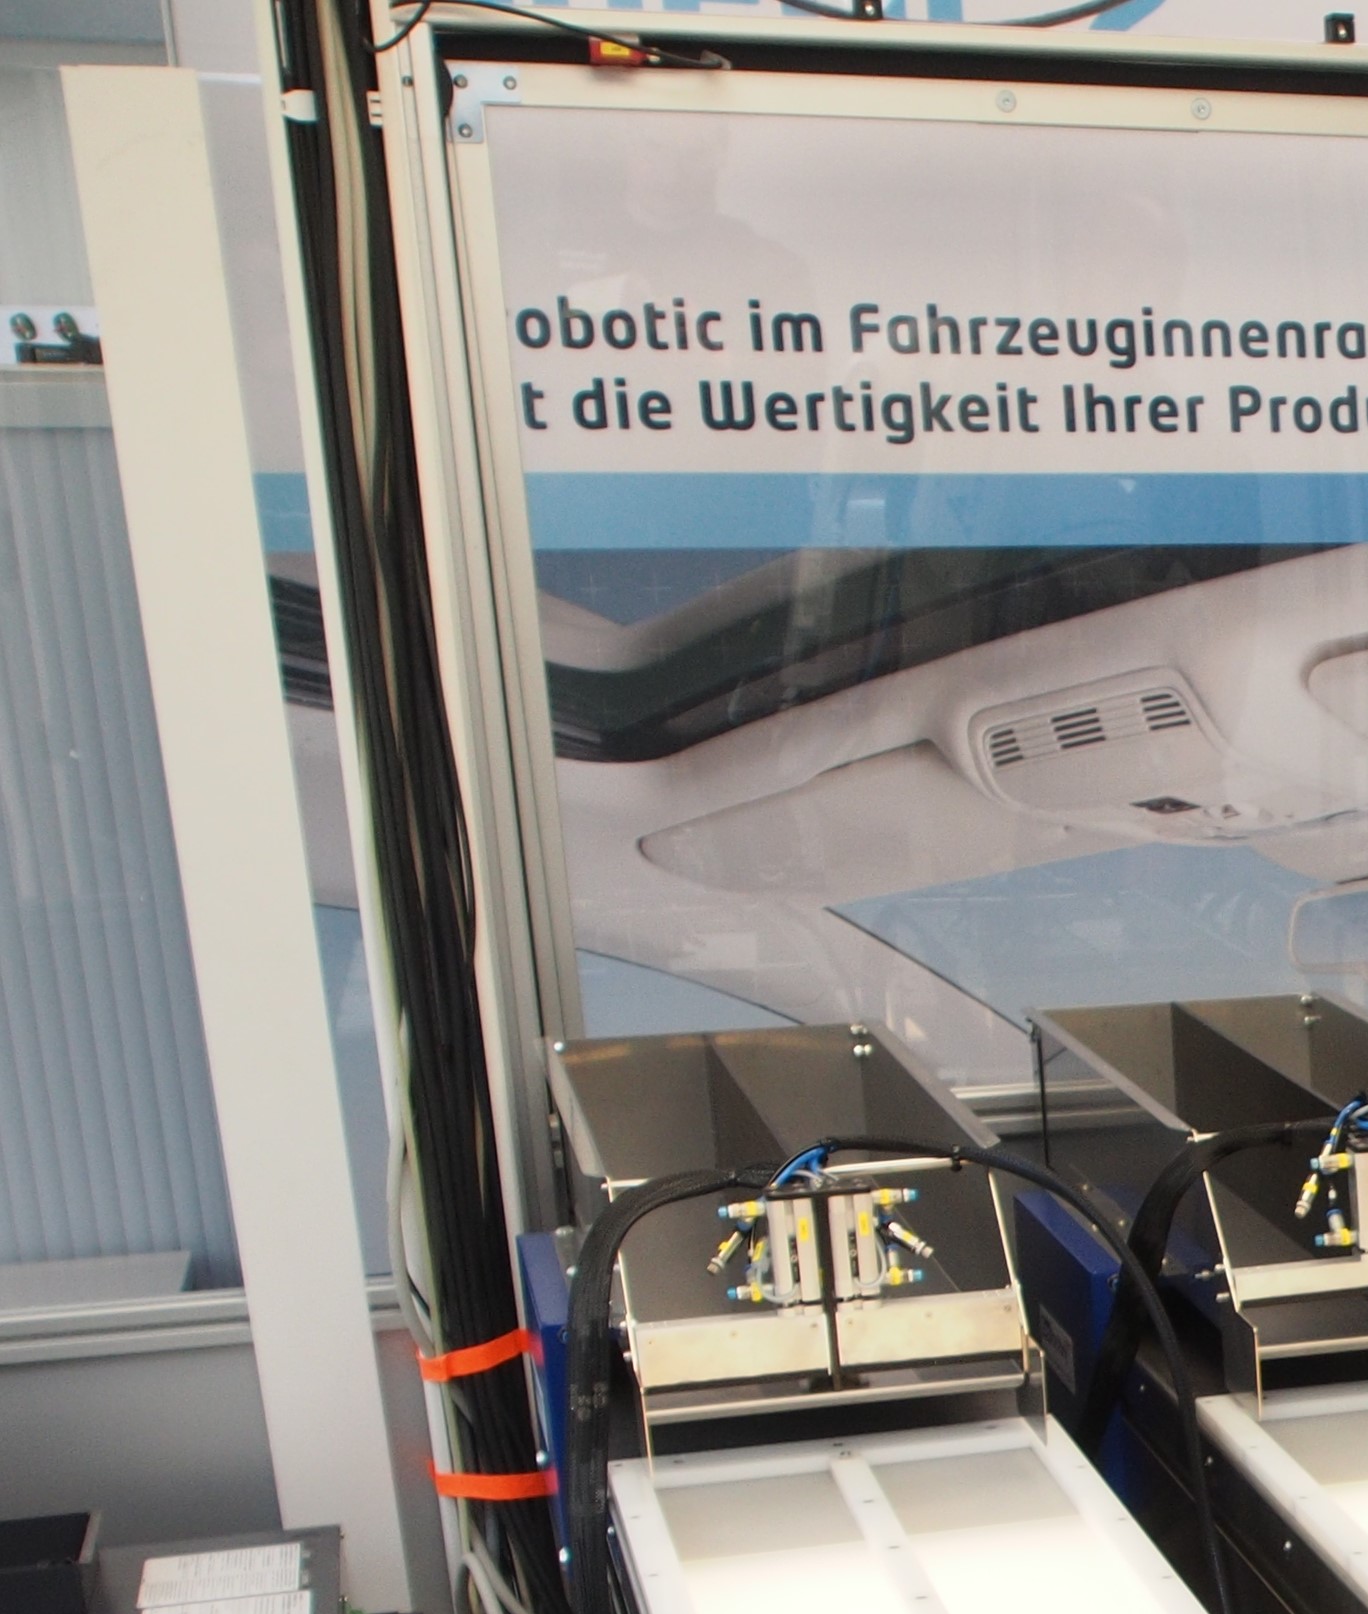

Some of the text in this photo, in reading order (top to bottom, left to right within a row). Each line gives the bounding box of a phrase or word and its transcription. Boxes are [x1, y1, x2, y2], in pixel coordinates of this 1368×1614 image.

[514, 295, 724, 351] obotic
[748, 298, 824, 353] im
[571, 376, 673, 431] die
[698, 379, 1040, 445] Wertigkeit
[1062, 382, 1205, 433] Ihrer
